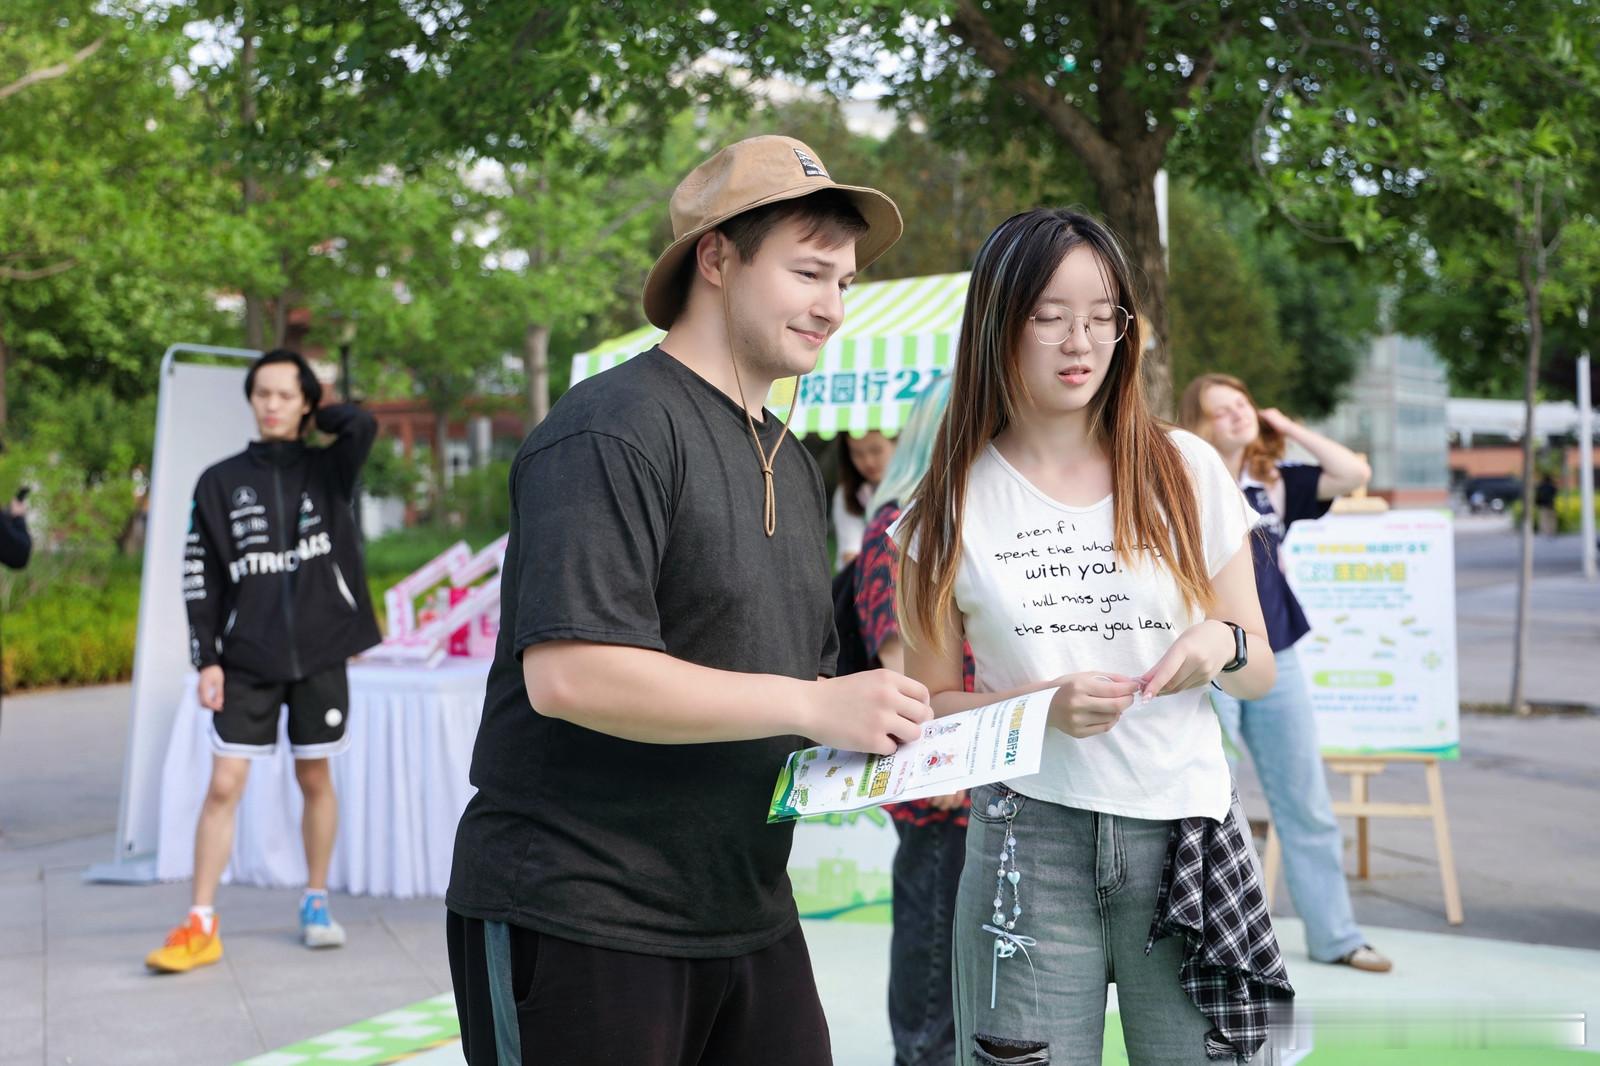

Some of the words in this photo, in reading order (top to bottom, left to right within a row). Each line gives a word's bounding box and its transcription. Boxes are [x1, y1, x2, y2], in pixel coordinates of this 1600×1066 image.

[801, 369, 942, 405] 校园行2
[1016, 528, 1052, 540] even
[1057, 520, 1066, 534] if
[995, 550, 1040, 565] spent
[1047, 545, 1075, 556] the
[1082, 540, 1116, 553] whol
[1025, 564, 1072, 580] with
[1078, 561, 1123, 580] you.
[1032, 595, 1058, 607] will
[1061, 592, 1094, 605] miss
[1100, 592, 1130, 613] you
[1014, 624, 1045, 637] the
[1049, 622, 1099, 633] second
[1103, 621, 1134, 640] you
[1138, 616, 1177, 631] leav
